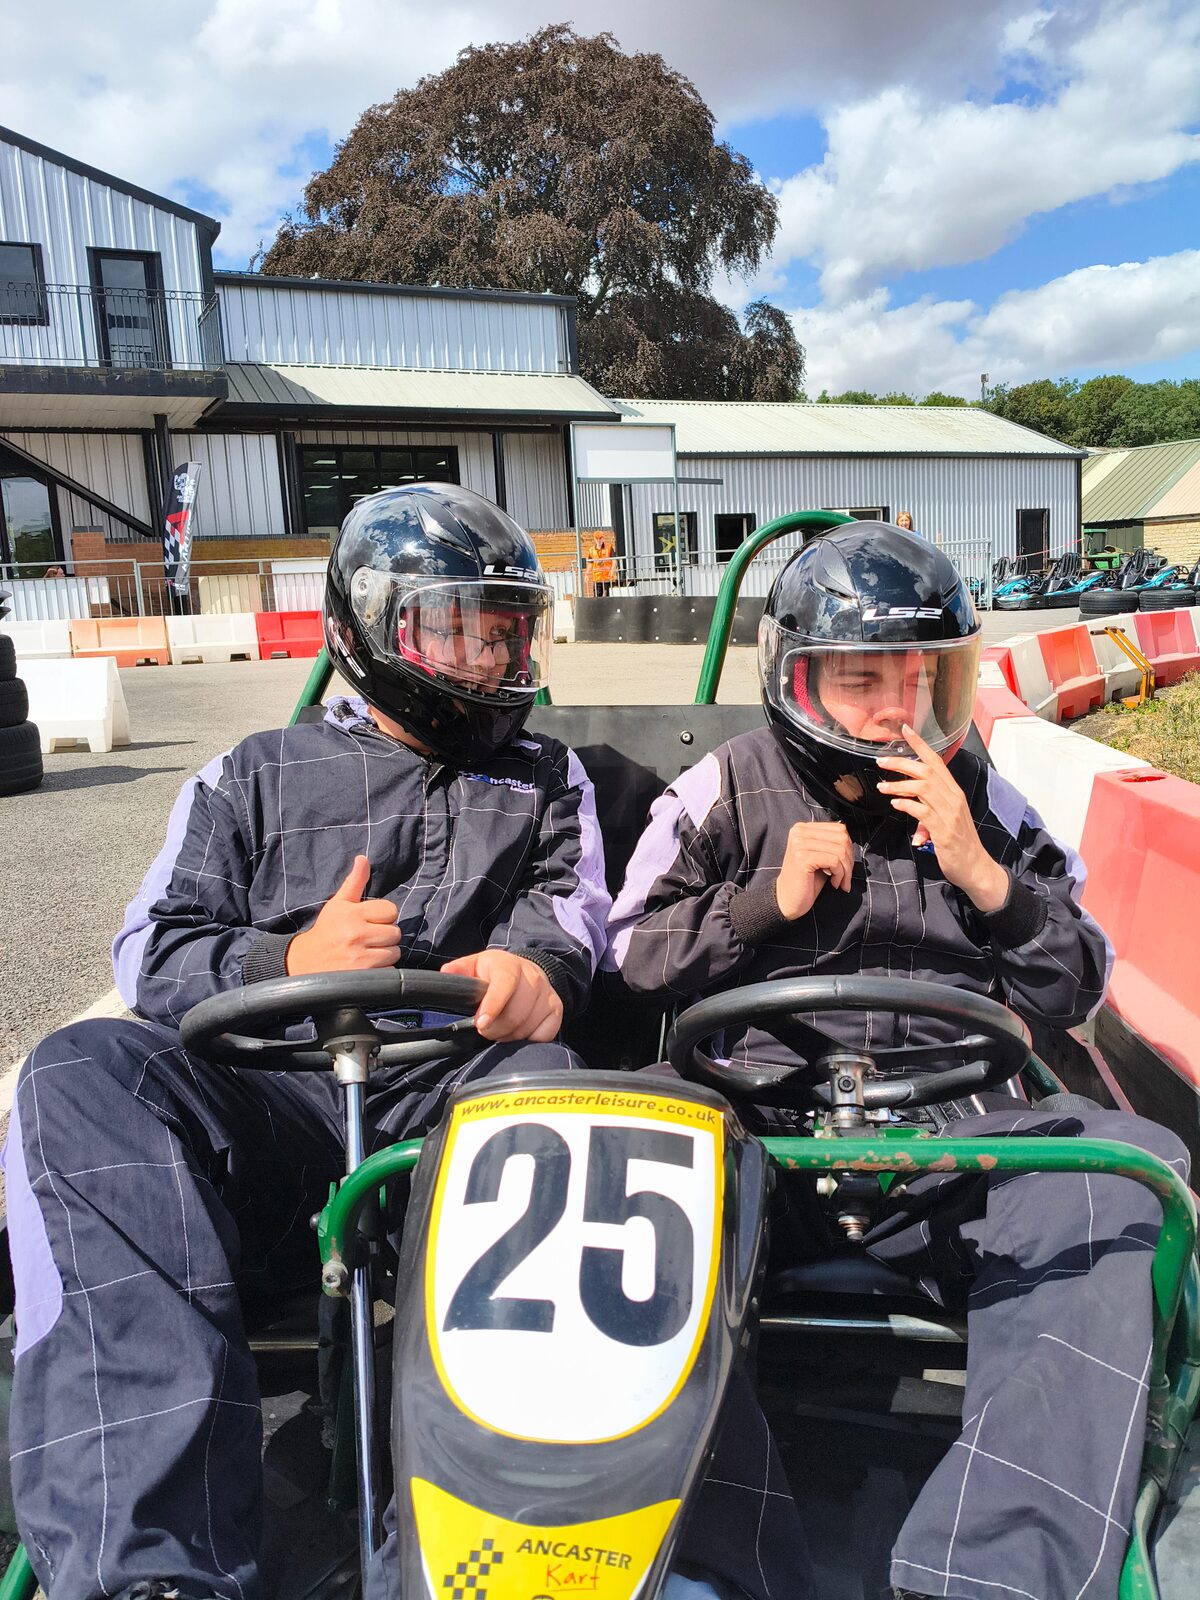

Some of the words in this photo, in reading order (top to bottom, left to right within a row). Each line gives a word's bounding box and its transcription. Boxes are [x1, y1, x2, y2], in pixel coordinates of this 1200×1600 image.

[483, 565, 539, 583] LS2
[862, 607, 943, 621] LS2
[461, 1092, 717, 1126] www.ancasterleisure.co.uk
[443, 1122, 694, 1347] 25
[516, 1538, 633, 1570] ANCASTER
[545, 1563, 602, 1589] Kart
